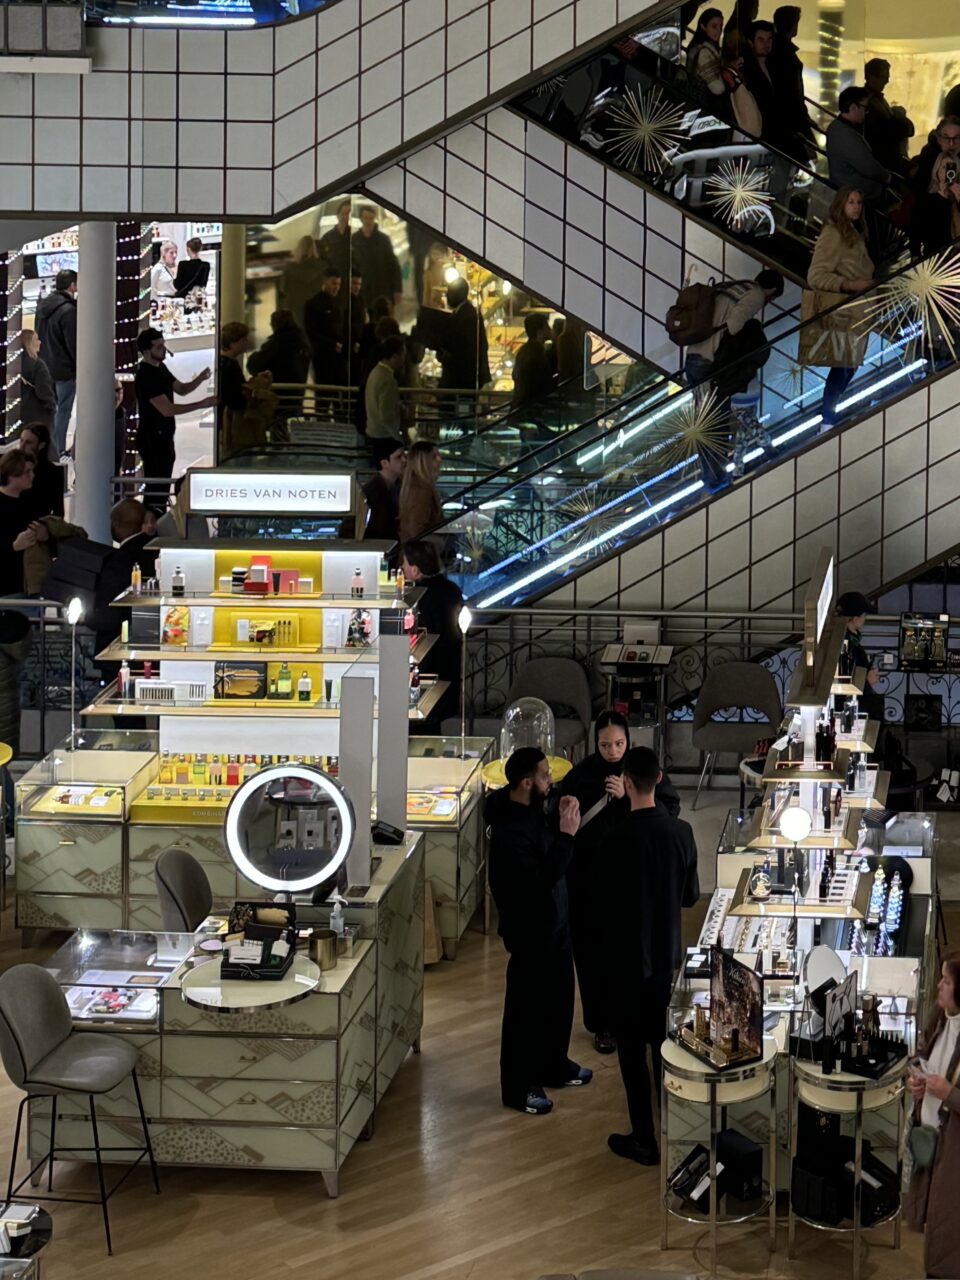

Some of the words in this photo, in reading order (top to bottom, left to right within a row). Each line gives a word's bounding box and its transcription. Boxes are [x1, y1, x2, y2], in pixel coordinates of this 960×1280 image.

[204, 488, 248, 499] DRIES
[253, 488, 282, 499] VAN
[288, 489, 337, 500] NOTEN
